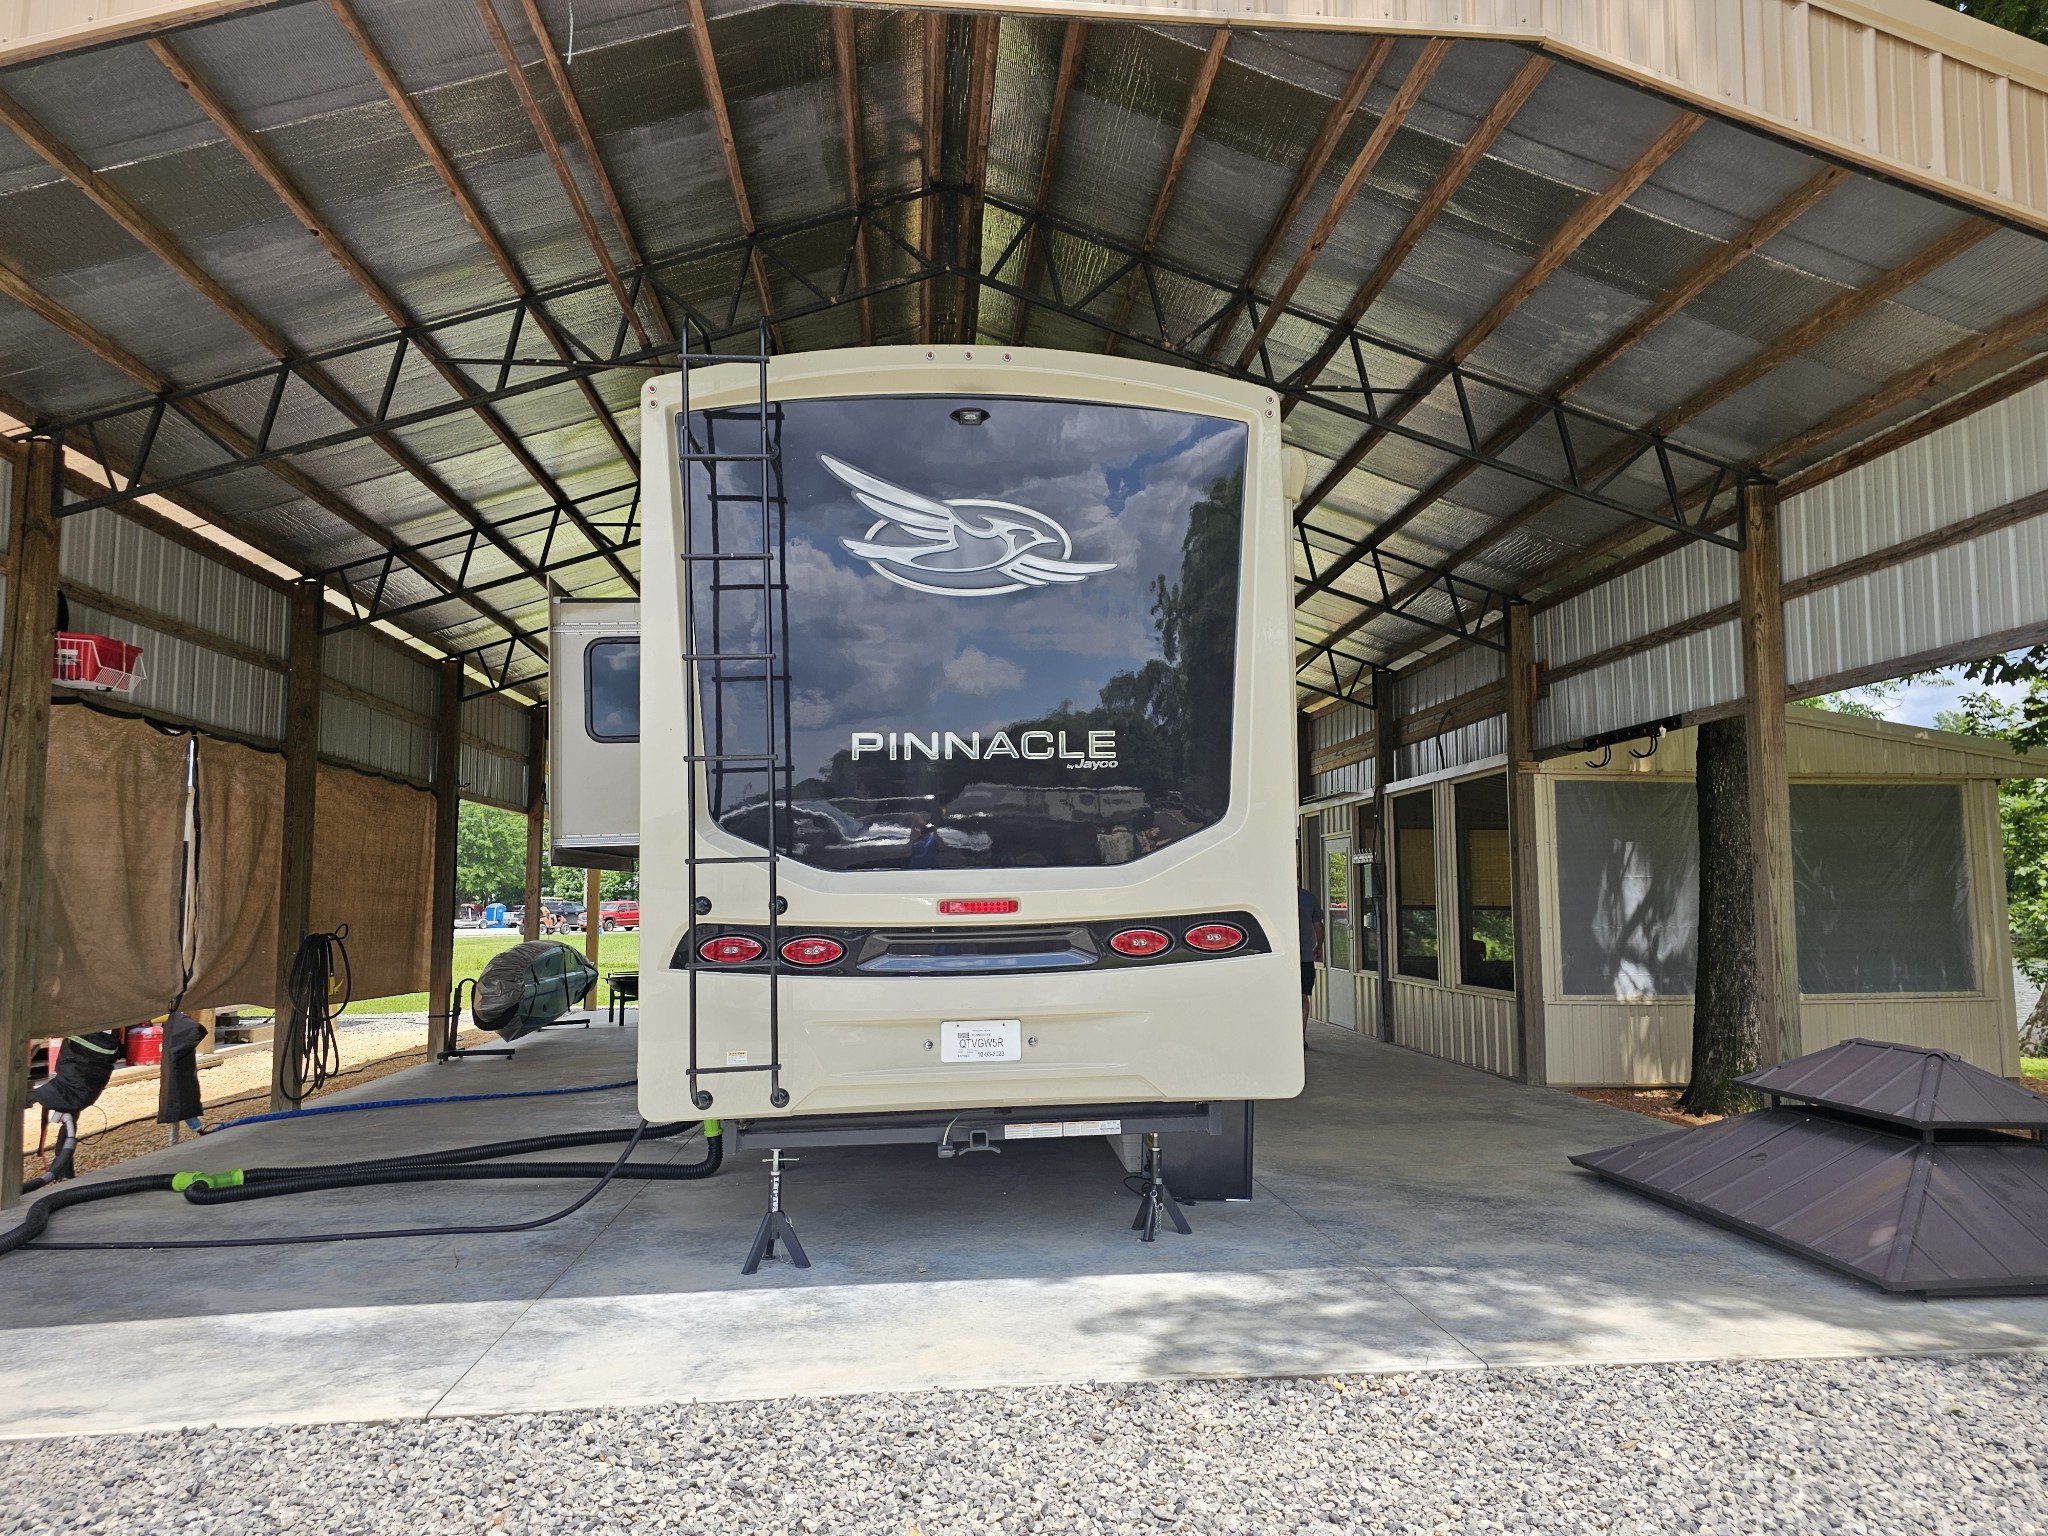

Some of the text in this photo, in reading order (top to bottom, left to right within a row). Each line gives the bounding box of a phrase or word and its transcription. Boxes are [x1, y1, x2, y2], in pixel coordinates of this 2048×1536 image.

[851, 730, 1116, 761] PINNACLE
[1074, 758, 1119, 771] Jayco
[959, 1037, 1004, 1048] QTVGW5R
